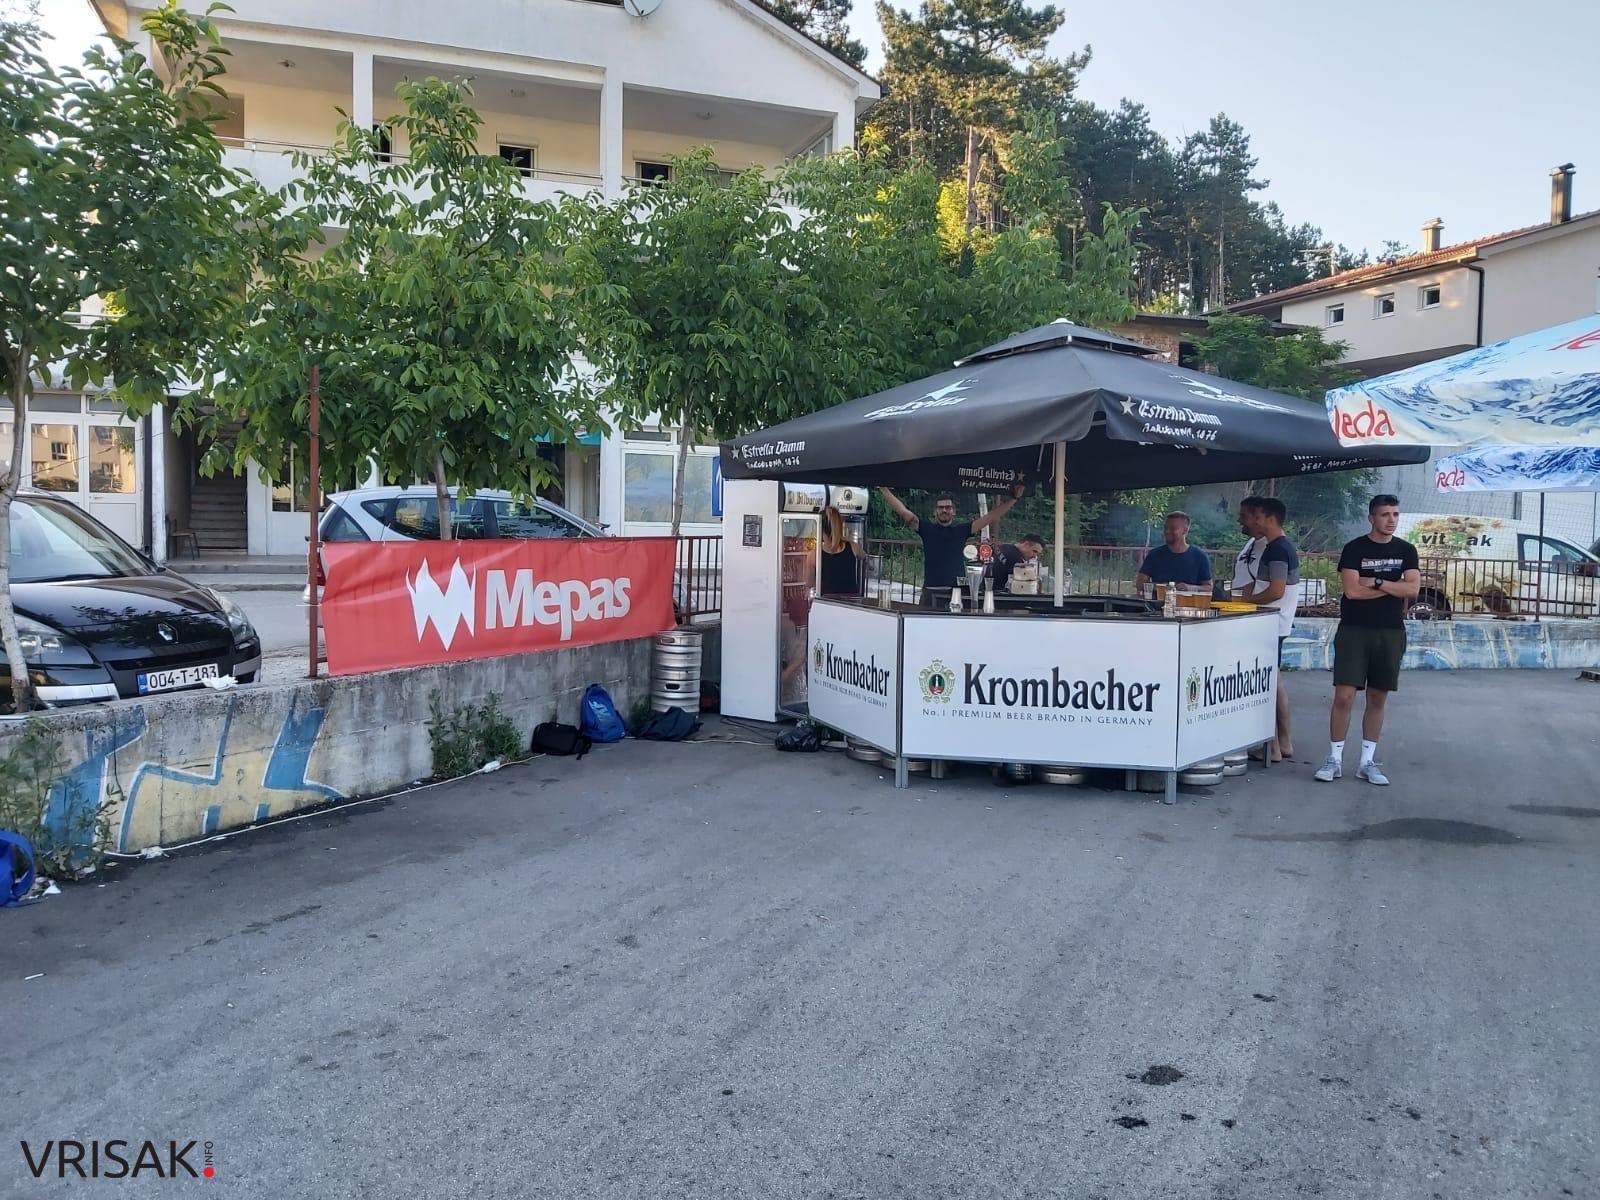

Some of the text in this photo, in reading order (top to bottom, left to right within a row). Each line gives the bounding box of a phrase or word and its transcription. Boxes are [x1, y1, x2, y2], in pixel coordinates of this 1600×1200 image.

[1138, 400, 1186, 421] Estrella
[1183, 408, 1222, 426] Damm
[1196, 430, 1218, 441] 1876
[741, 441, 806, 459] Estrella Damm
[1455, 531, 1493, 547] Pak
[485, 568, 632, 641] Mepas
[149, 665, 217, 689] 004-T-183
[826, 642, 890, 697] Krombacher
[1203, 655, 1273, 707] Krombacher
[963, 662, 1161, 713] Krombacher
[952, 709, 1002, 720] PREMIUM
[1006, 711, 1033, 721] BEER
[1037, 713, 1075, 723] BRAND
[1081, 715, 1092, 724] IN
[1097, 716, 1153, 726] GERMANY
